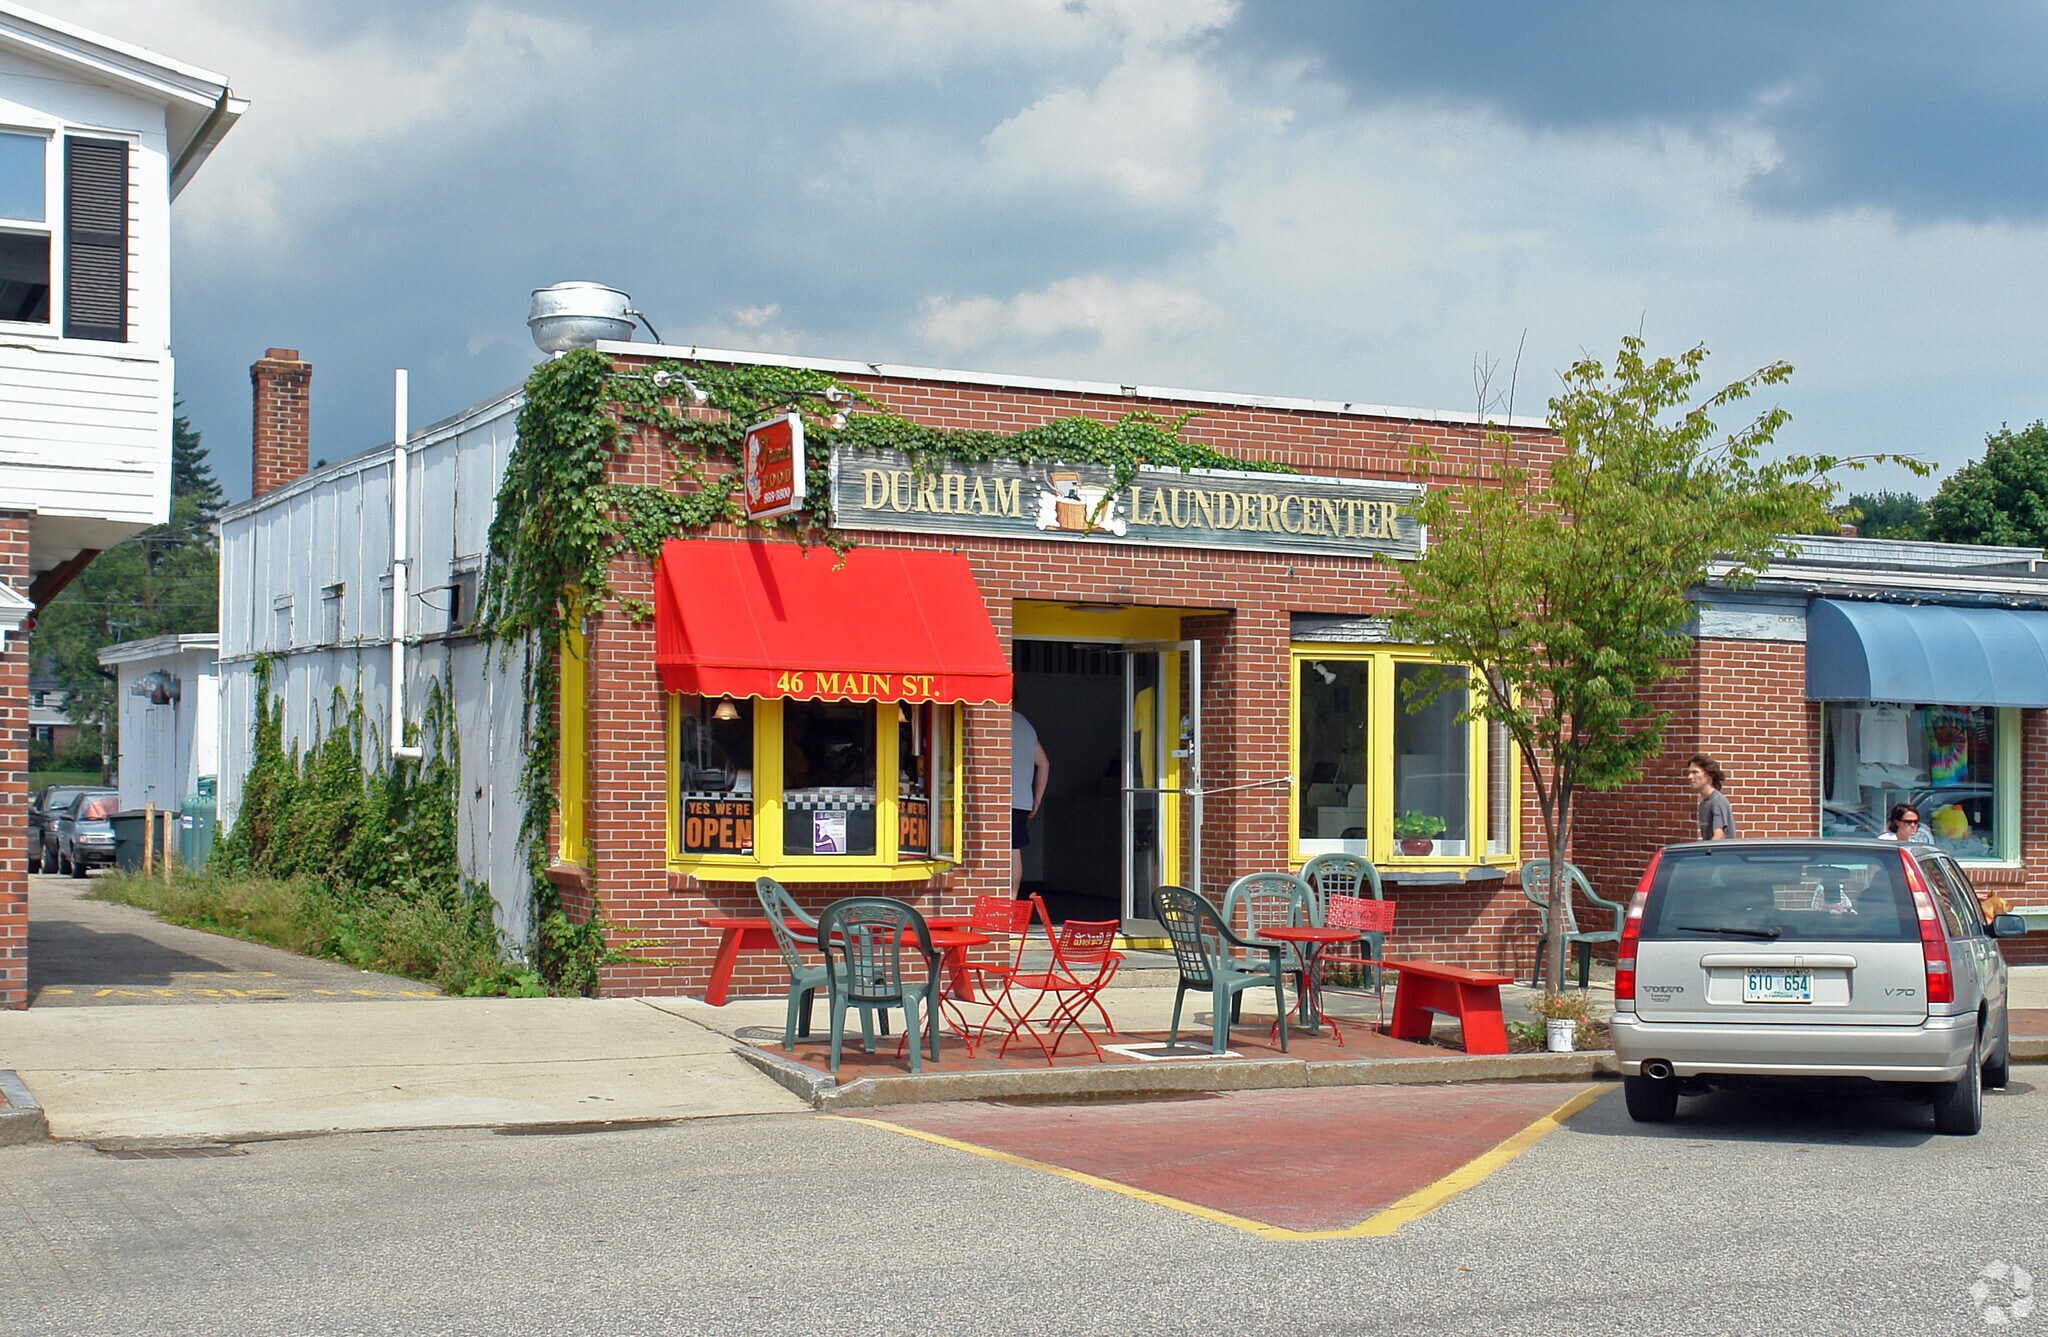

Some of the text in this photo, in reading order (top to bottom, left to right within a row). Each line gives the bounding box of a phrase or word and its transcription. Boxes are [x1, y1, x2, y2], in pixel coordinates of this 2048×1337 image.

[763, 468, 791, 489] FOOD
[862, 469, 1401, 540] DURHAM LAUNDERCENTER
[777, 671, 940, 697] 46 MAIN ST.
[689, 802, 750, 816] YES WE'RE
[686, 817, 752, 849] OPEN
[899, 816, 927, 847] PEN
[1642, 985, 1685, 993] VOLVO
[1749, 975, 1808, 991] 610 654
